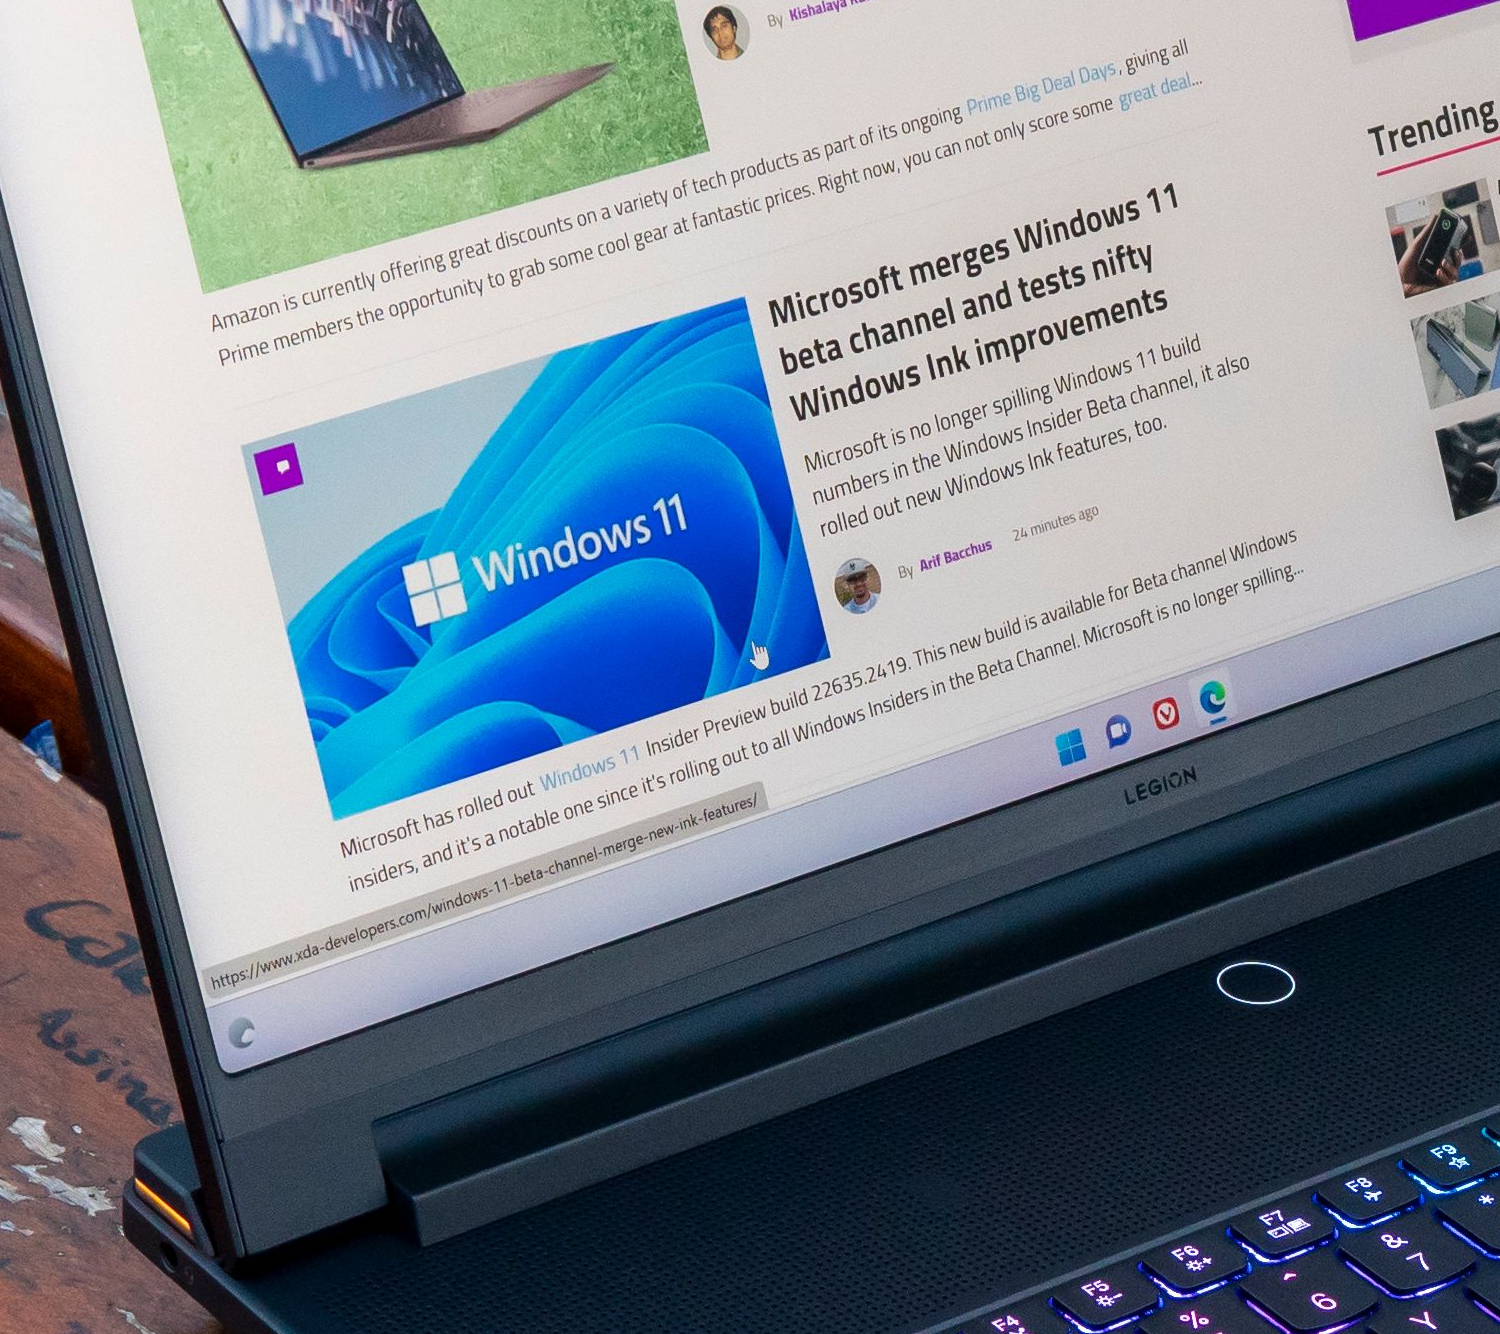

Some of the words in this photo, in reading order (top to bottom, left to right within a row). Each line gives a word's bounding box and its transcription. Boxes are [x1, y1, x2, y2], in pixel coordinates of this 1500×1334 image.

[1366, 99, 1499, 156] Trending
[768, 265, 904, 328] Microsoft
[908, 238, 1010, 286] merges
[1013, 199, 1141, 254] Windows
[1146, 182, 1178, 213] 11
[778, 338, 844, 375] beta
[849, 296, 956, 354] channel
[961, 279, 1013, 320] and
[1017, 264, 1086, 303] tests
[1091, 243, 1152, 281] nifty
[788, 364, 921, 422] Windows
[925, 344, 971, 380] Ink
[974, 289, 1168, 366] improvements
[472, 514, 652, 591] Windows
[652, 493, 687, 535] 11
[1123, 765, 1197, 805] LEGION
[209, 791, 758, 991] https://www.xda-developers.com/windows-11-beta-channel-merge-new-ink-features/
[1430, 1144, 1457, 1161] F9
[1344, 1176, 1373, 1194] F8
[1259, 1210, 1284, 1227] F7
[1171, 1244, 1200, 1262] F6
[1081, 1279, 1110, 1297] F5
[991, 1315, 1019, 1333] F4
